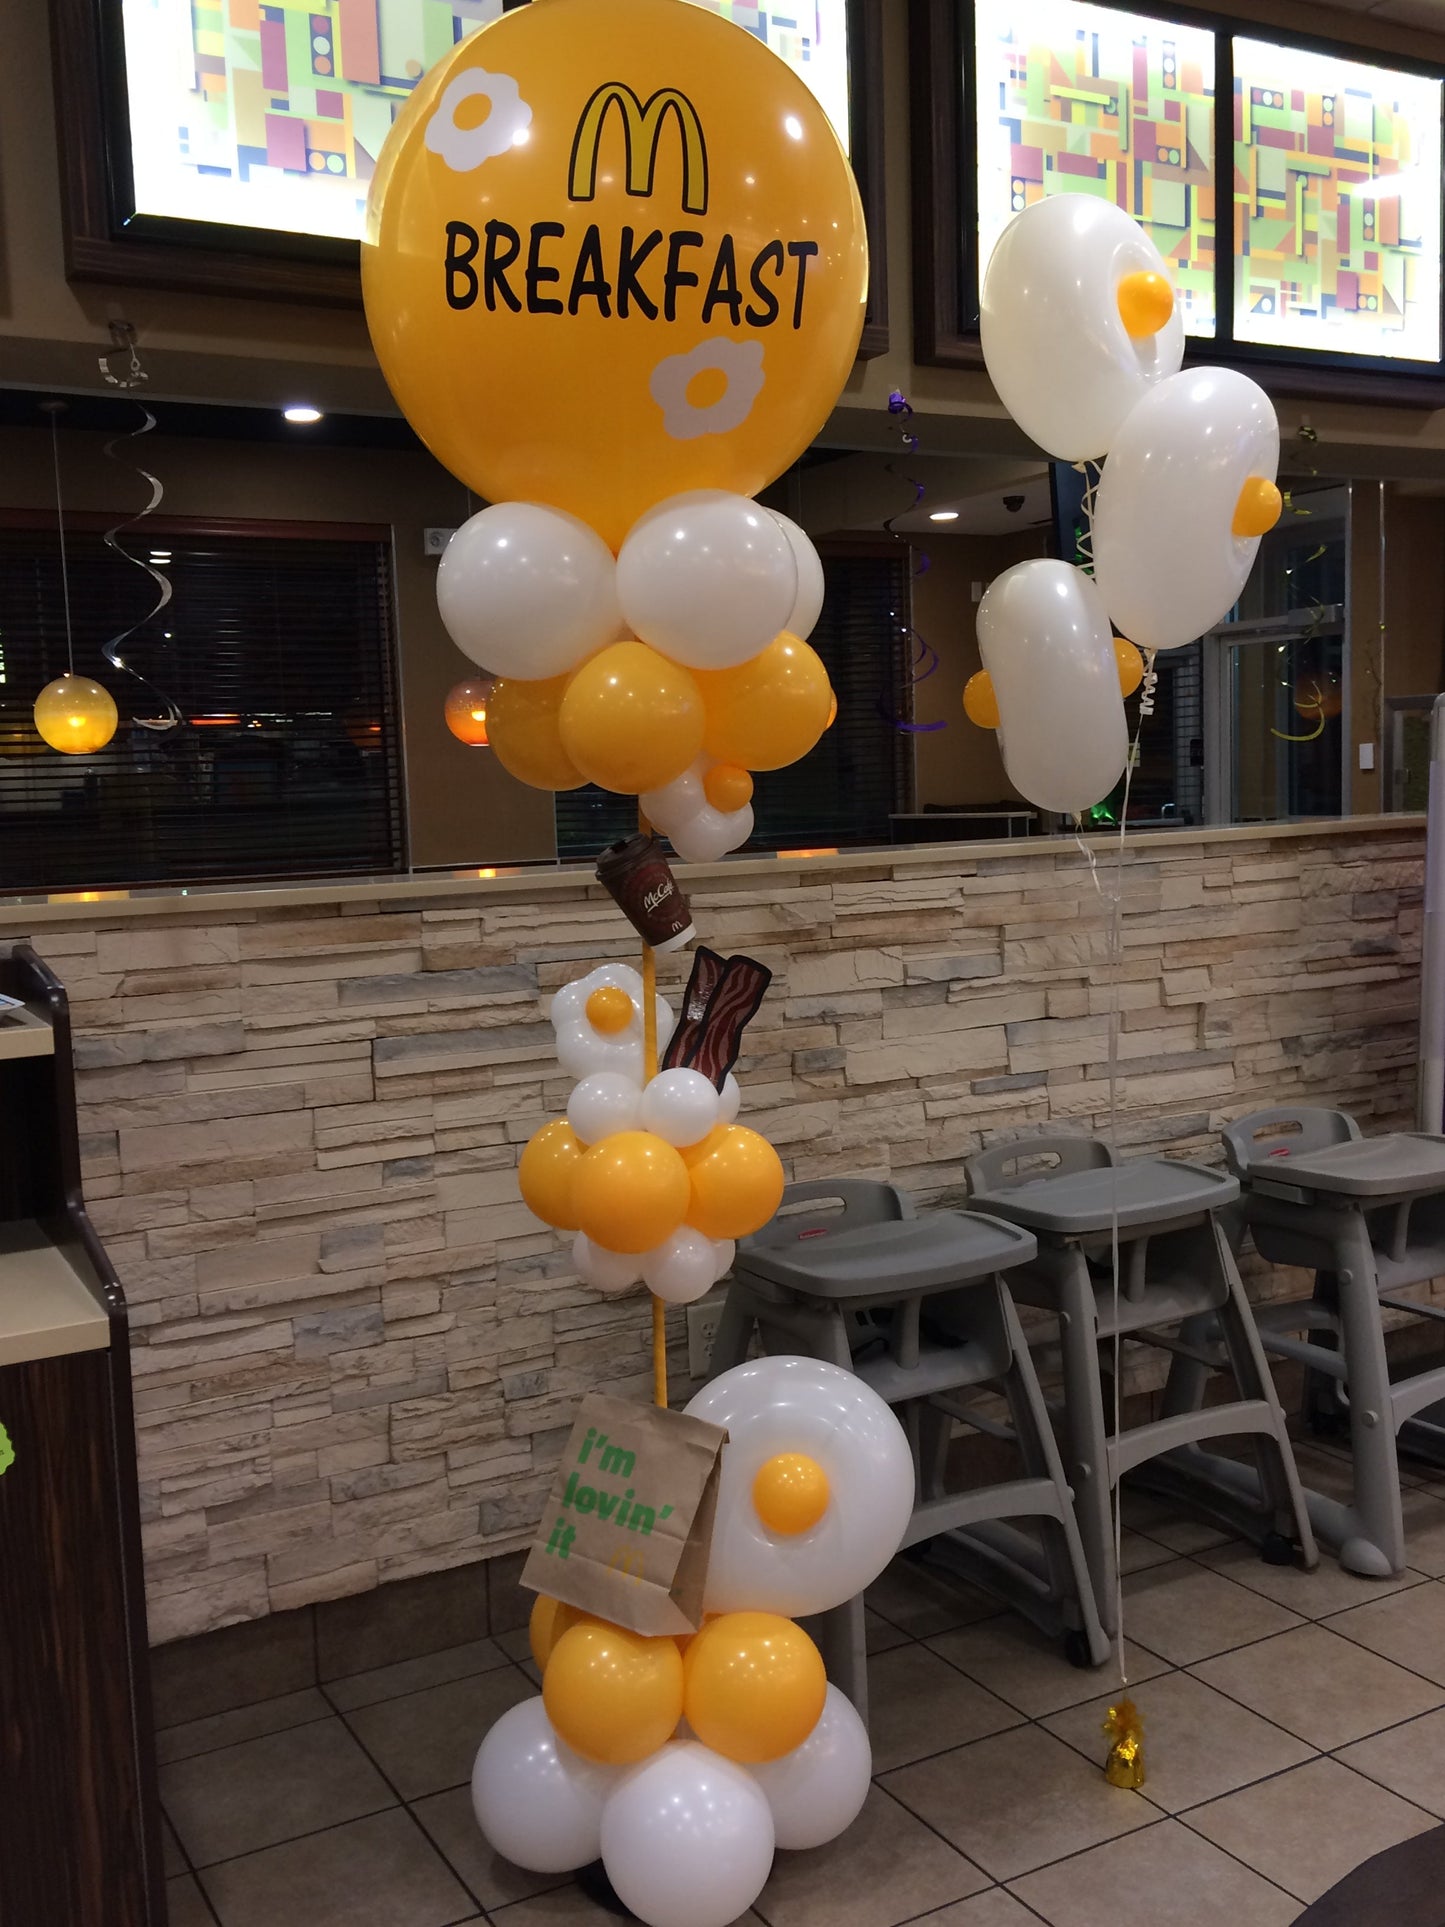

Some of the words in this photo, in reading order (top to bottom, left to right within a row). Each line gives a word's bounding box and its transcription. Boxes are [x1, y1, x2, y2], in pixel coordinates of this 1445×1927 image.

[445, 219, 818, 329] BREAKFAST
[577, 1427, 636, 1478] i'm
[562, 1471, 674, 1536] lovin'
[545, 1517, 576, 1559] it
